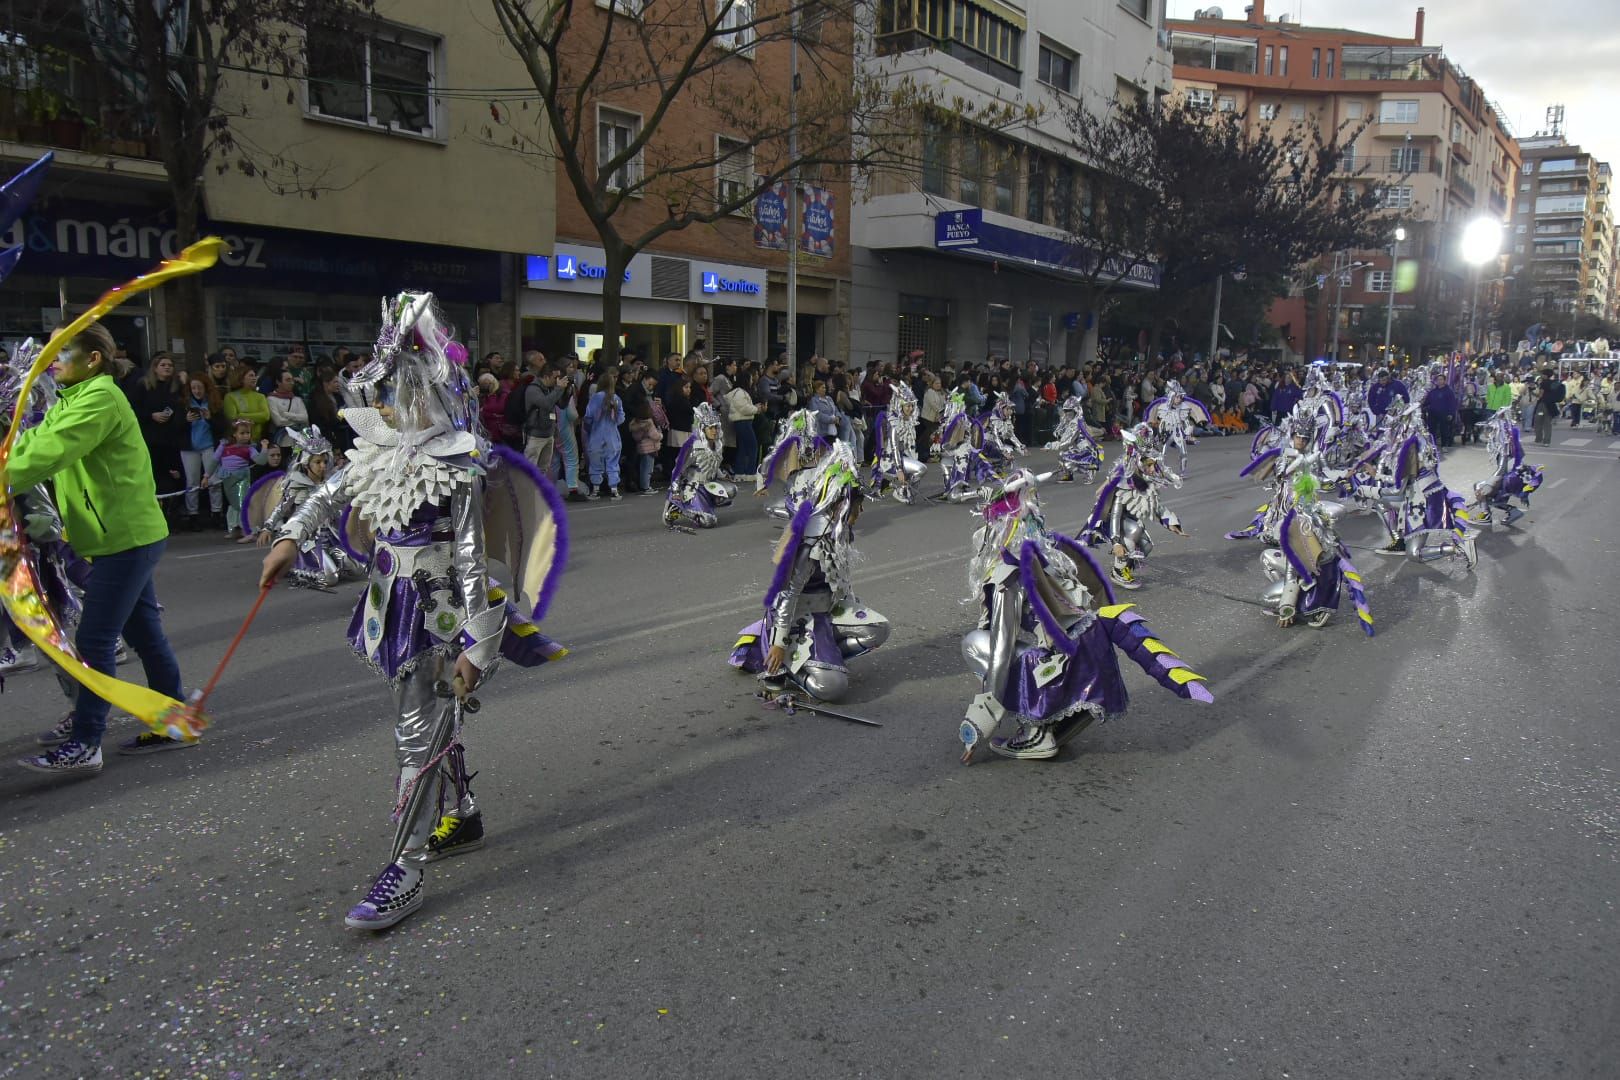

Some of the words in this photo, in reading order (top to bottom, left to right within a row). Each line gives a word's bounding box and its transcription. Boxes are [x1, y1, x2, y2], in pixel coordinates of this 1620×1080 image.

[946, 223, 970, 232] BANCA
[946, 230, 970, 239] PUEYO
[578, 262, 632, 283] Sans
[719, 278, 761, 294] Sanitas
